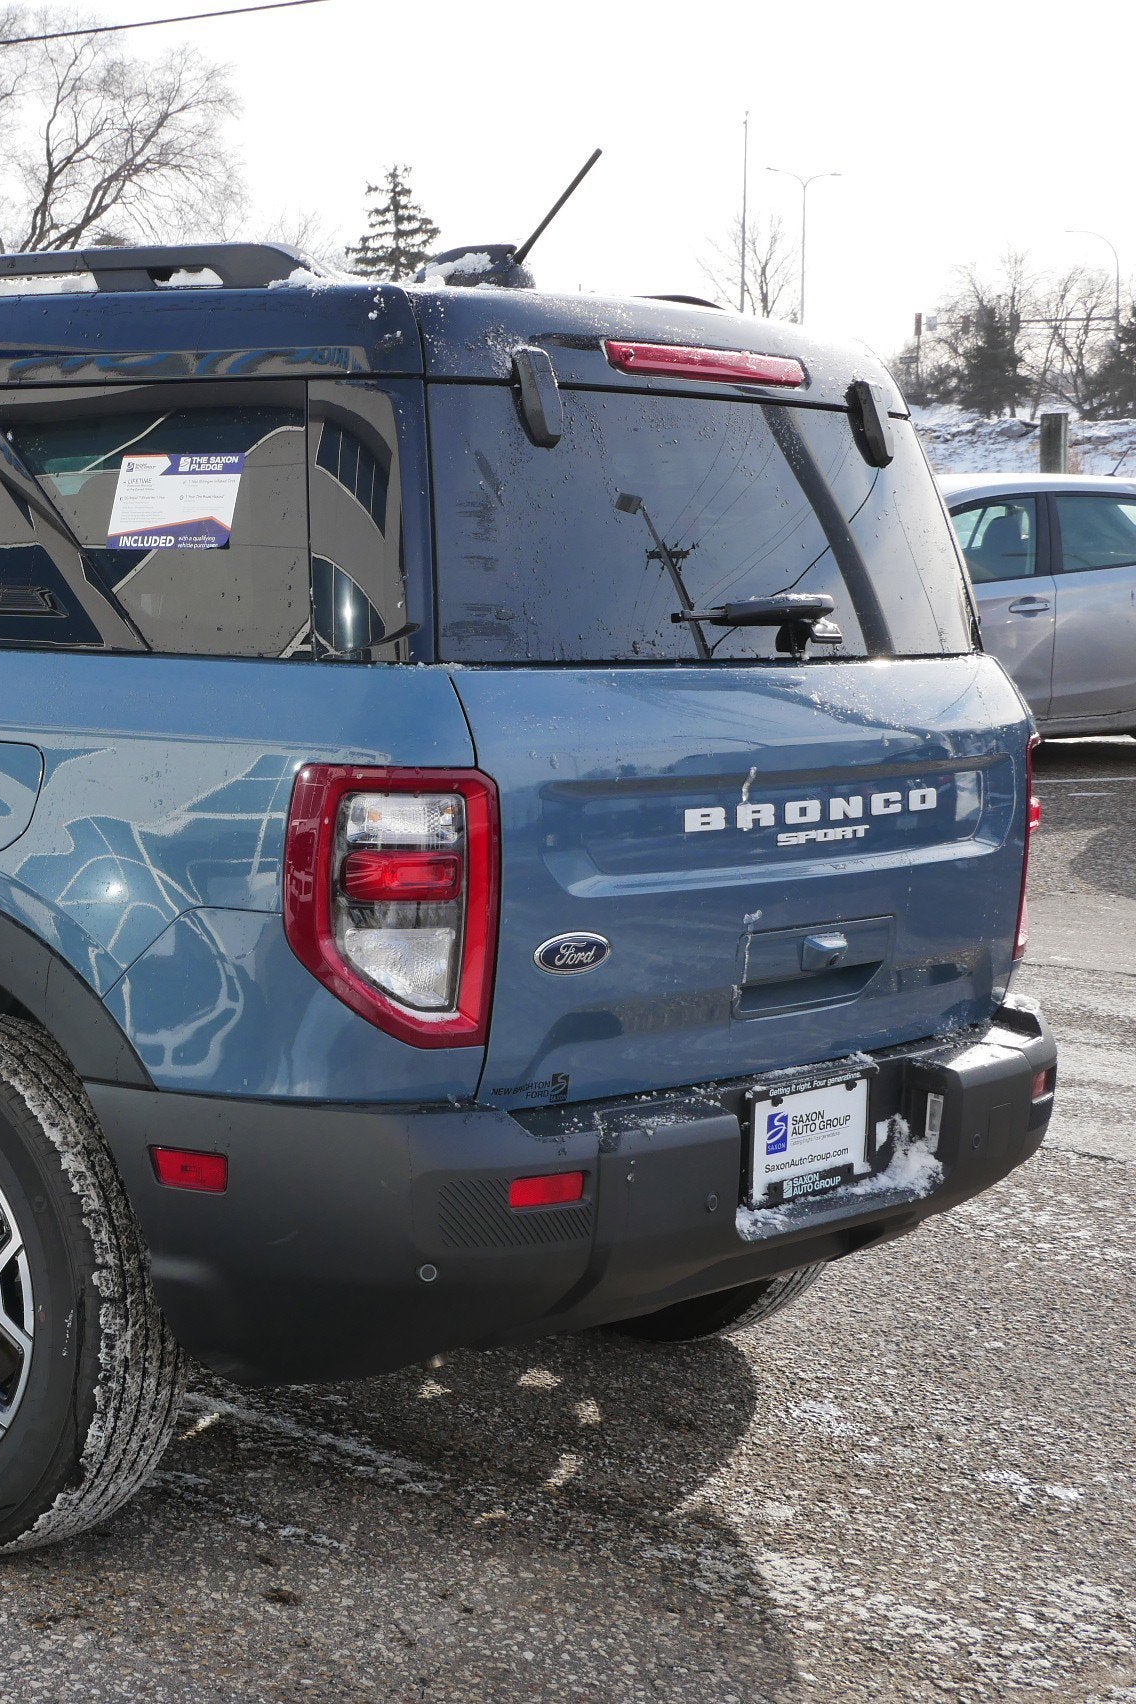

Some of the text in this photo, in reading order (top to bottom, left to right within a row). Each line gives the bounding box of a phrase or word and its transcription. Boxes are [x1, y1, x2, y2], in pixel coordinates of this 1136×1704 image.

[190, 463, 223, 471] PLEDGE
[192, 456, 239, 464] THE SAXON
[119, 535, 175, 547] INCLUDED
[684, 787, 938, 833] BRONCO
[776, 824, 870, 847] SPORT
[554, 941, 596, 968] Ford
[491, 1087, 512, 1096] NEW
[526, 1089, 549, 1099] FORD
[769, 1086, 791, 1097] Getting
[812, 1080, 827, 1088] Four
[791, 1110, 825, 1126] SAXON
[791, 1114, 851, 1137] AUTO GROUP
[767, 1142, 786, 1152] SAXON
[764, 1147, 849, 1173] SaxonAutoGroup.com
[792, 1173, 820, 1187] SAXON
[792, 1175, 842, 1196] AUTO GROUP
